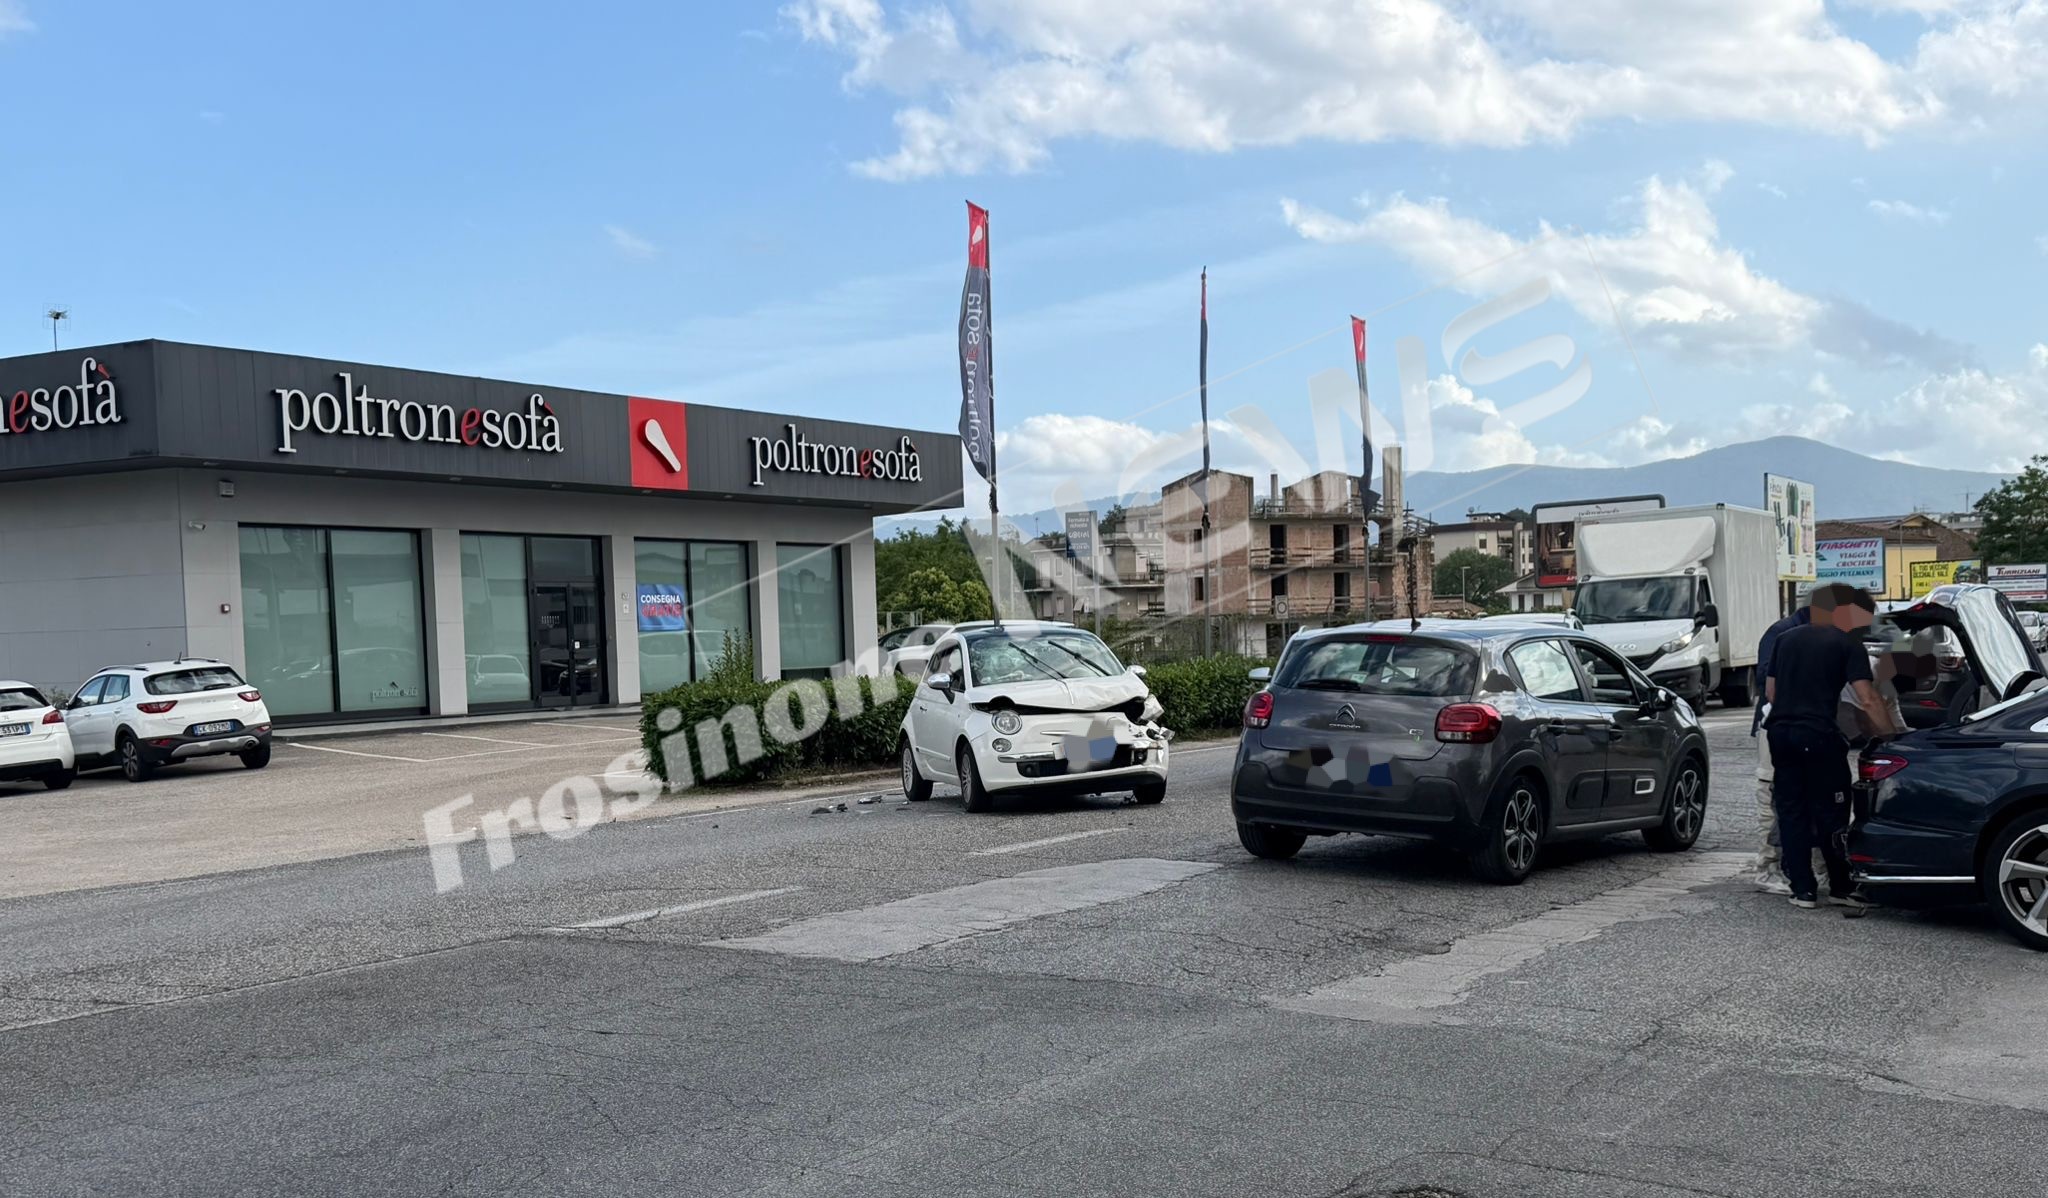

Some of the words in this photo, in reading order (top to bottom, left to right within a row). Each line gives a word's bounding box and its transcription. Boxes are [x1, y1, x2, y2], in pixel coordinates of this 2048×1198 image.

[274, 372, 563, 454] poltronesofà
[750, 423, 923, 486] poltronesofà
[1820, 540, 1879, 550] FIASCHETTI
[1840, 551, 1867, 559] VIAGGI
[1868, 550, 1876, 558] &
[640, 594, 681, 604] CONSEGNA
